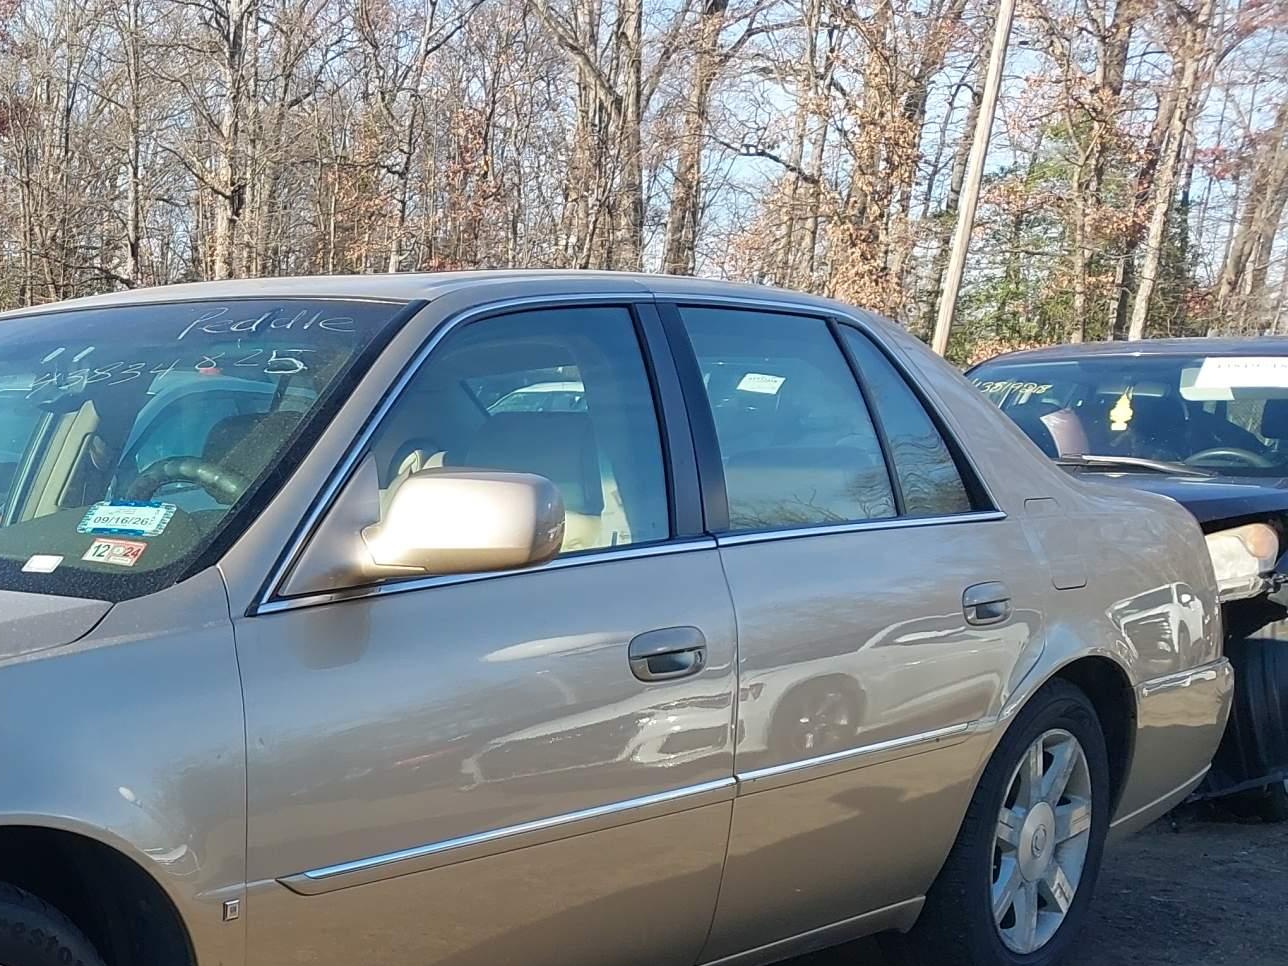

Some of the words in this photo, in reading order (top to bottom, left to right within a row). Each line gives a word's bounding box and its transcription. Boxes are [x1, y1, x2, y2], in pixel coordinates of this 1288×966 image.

[93, 516, 149, 526] 09/16/26
[92, 543, 110, 557] 12
[123, 546, 142, 559] 24
